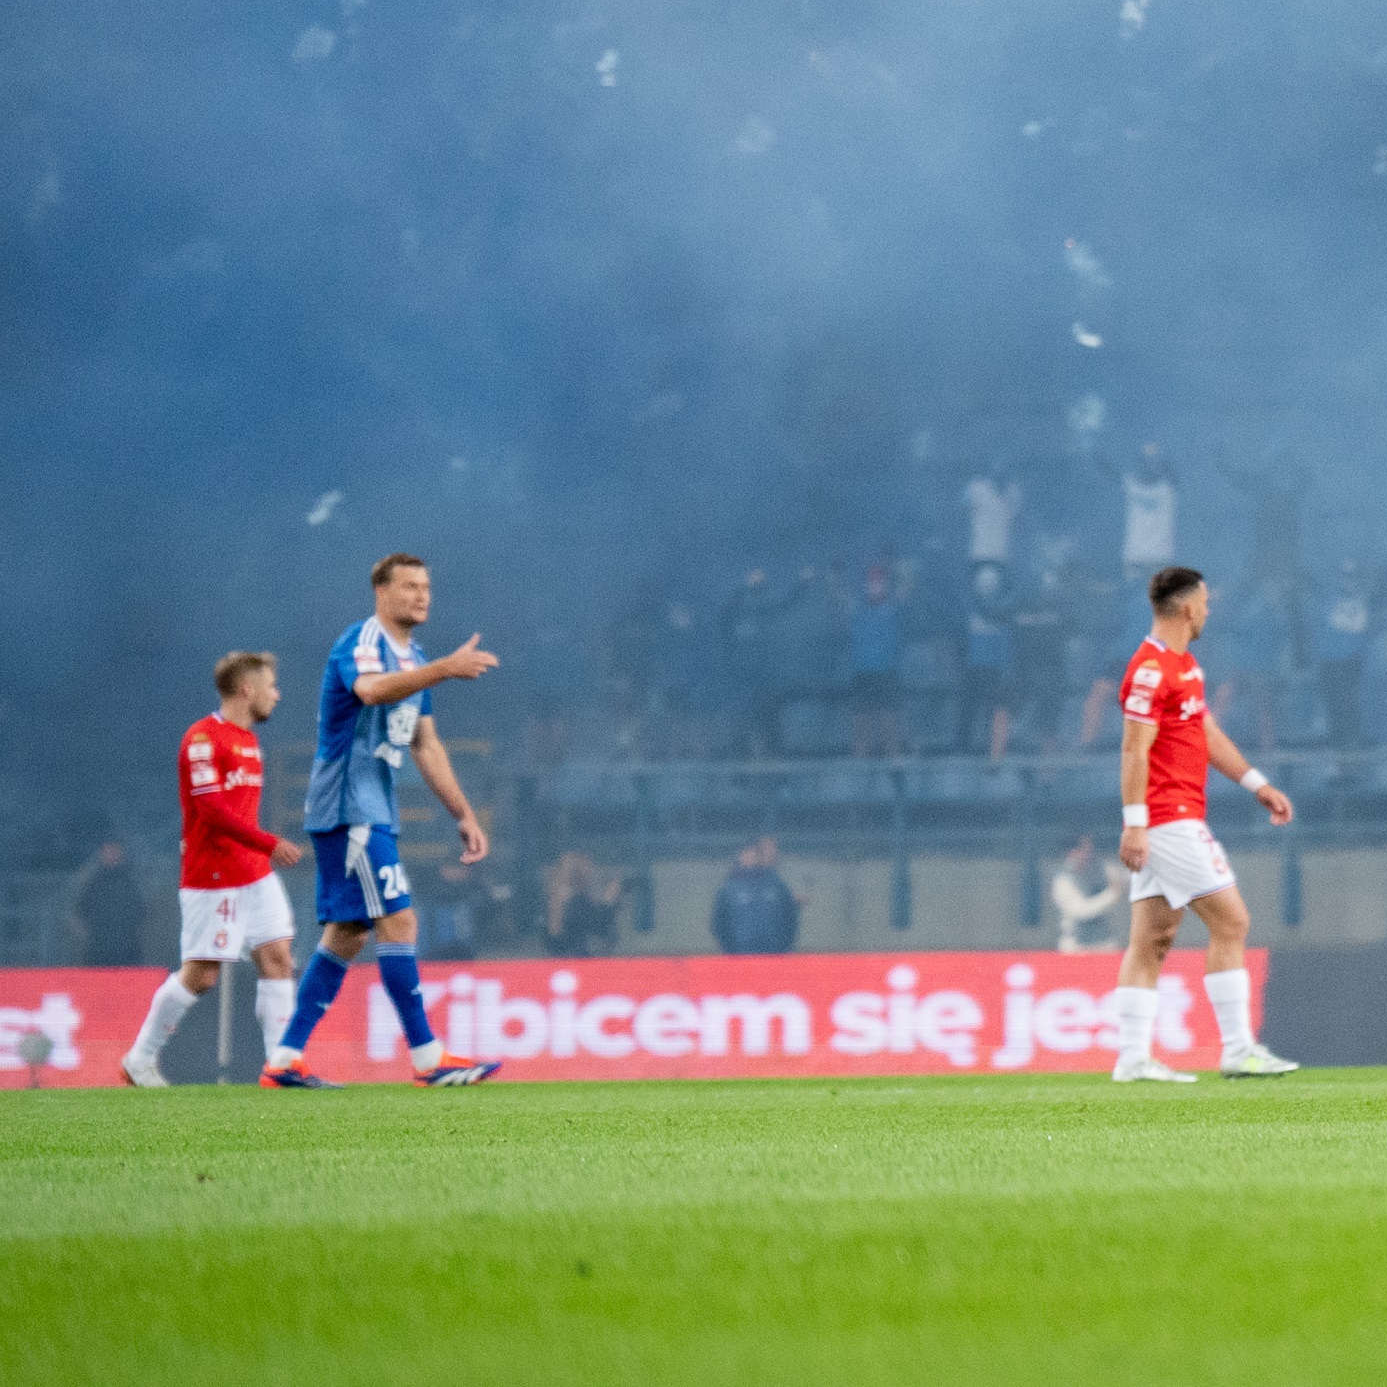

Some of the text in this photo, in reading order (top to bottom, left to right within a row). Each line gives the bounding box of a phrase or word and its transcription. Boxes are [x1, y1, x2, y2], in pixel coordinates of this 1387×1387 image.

[0, 993, 81, 1071] st
[367, 970, 811, 1062] Kibicem
[829, 963, 984, 1068] się
